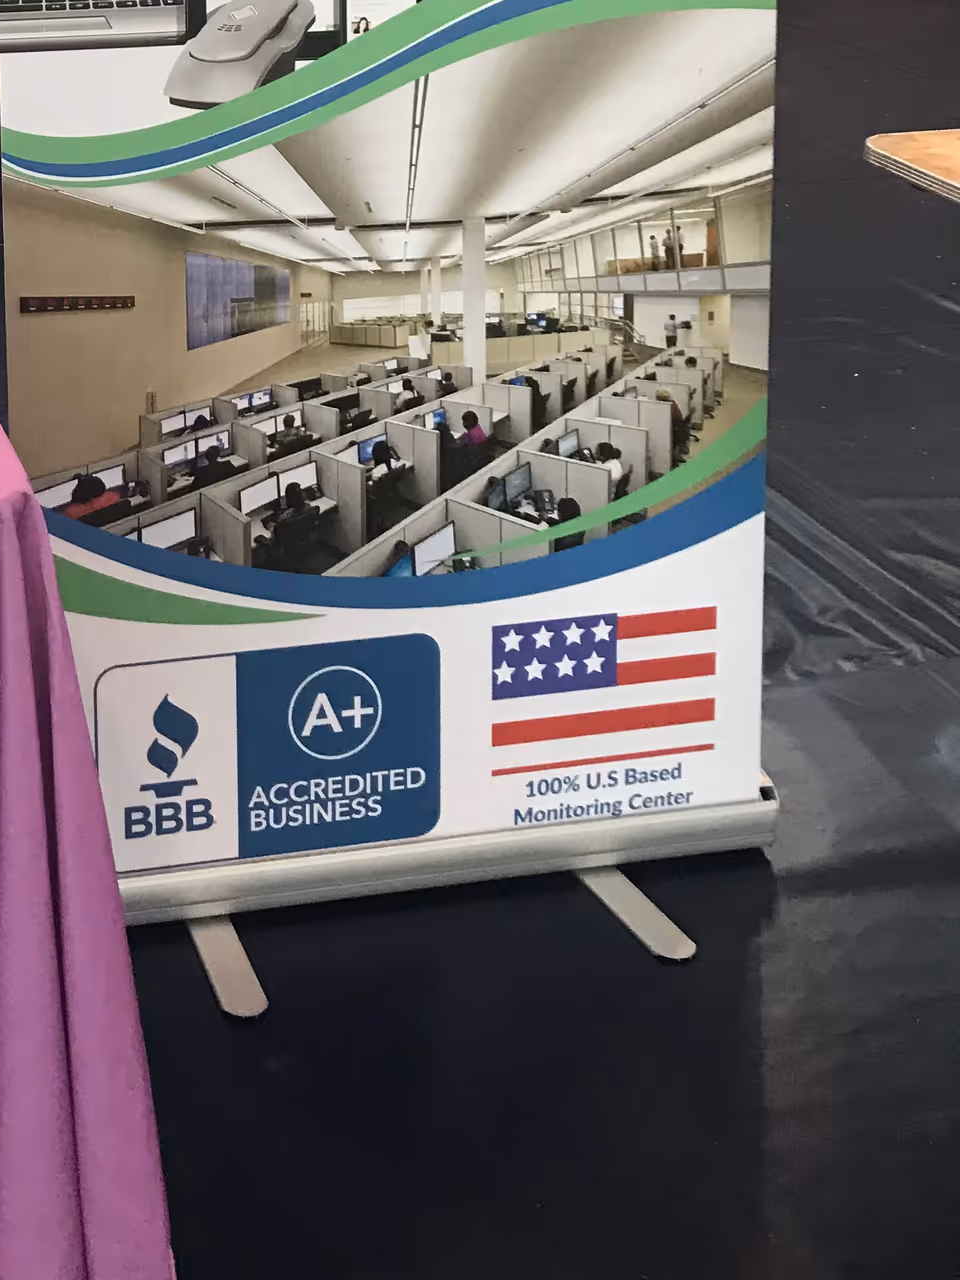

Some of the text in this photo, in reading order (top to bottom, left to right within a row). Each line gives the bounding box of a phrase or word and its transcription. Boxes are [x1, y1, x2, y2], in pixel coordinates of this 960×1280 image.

[301, 692, 374, 737] A+
[249, 766, 426, 808] ACCREDITED
[525, 762, 683, 798] 100% U.S Based
[124, 798, 214, 840] BBB
[250, 795, 382, 832] BUSINESS
[514, 790, 694, 826] Monitoring Center
